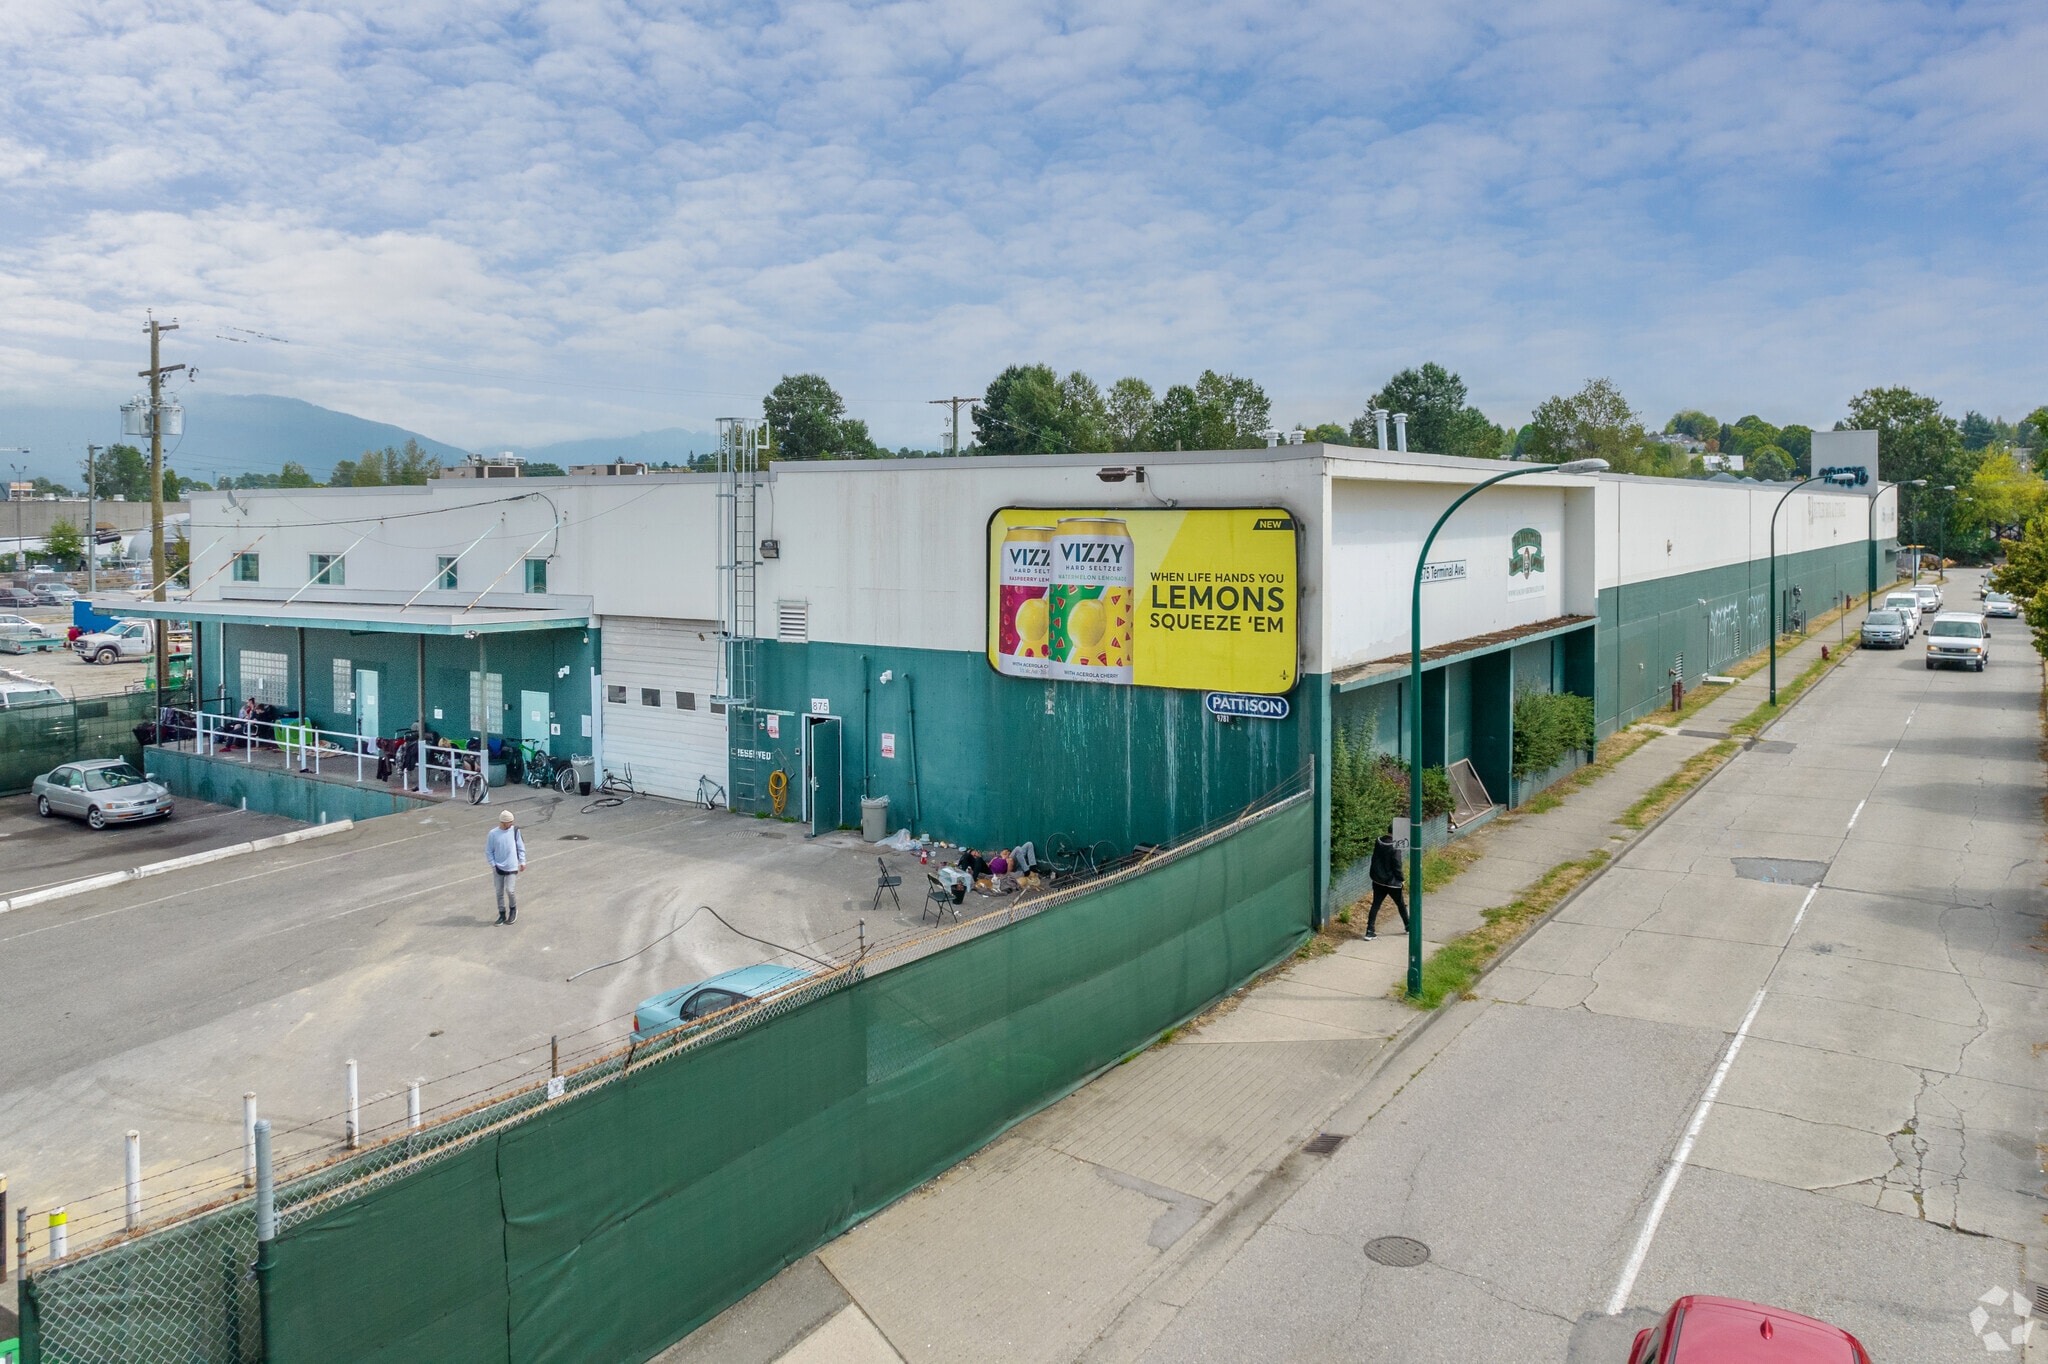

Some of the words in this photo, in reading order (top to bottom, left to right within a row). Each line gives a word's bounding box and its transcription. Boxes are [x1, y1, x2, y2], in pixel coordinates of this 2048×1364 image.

[1260, 520, 1282, 529] NEW
[1060, 543, 1125, 563] VIZZY
[1058, 573, 1097, 581] WATERMELON
[1098, 574, 1127, 582] LEMONADE
[1150, 572, 1184, 582] WHEN
[1187, 572, 1212, 582] LIFE
[1215, 573, 1255, 583] HANDS
[1258, 573, 1285, 584] YOU
[1431, 564, 1454, 579] Terminal
[1152, 585, 1285, 612] LEMONS
[1150, 612, 1241, 631] SQUEEZE
[1076, 671, 1100, 679] ACEROLA
[812, 700, 829, 711] 875
[1212, 696, 1282, 714] PATTISON
